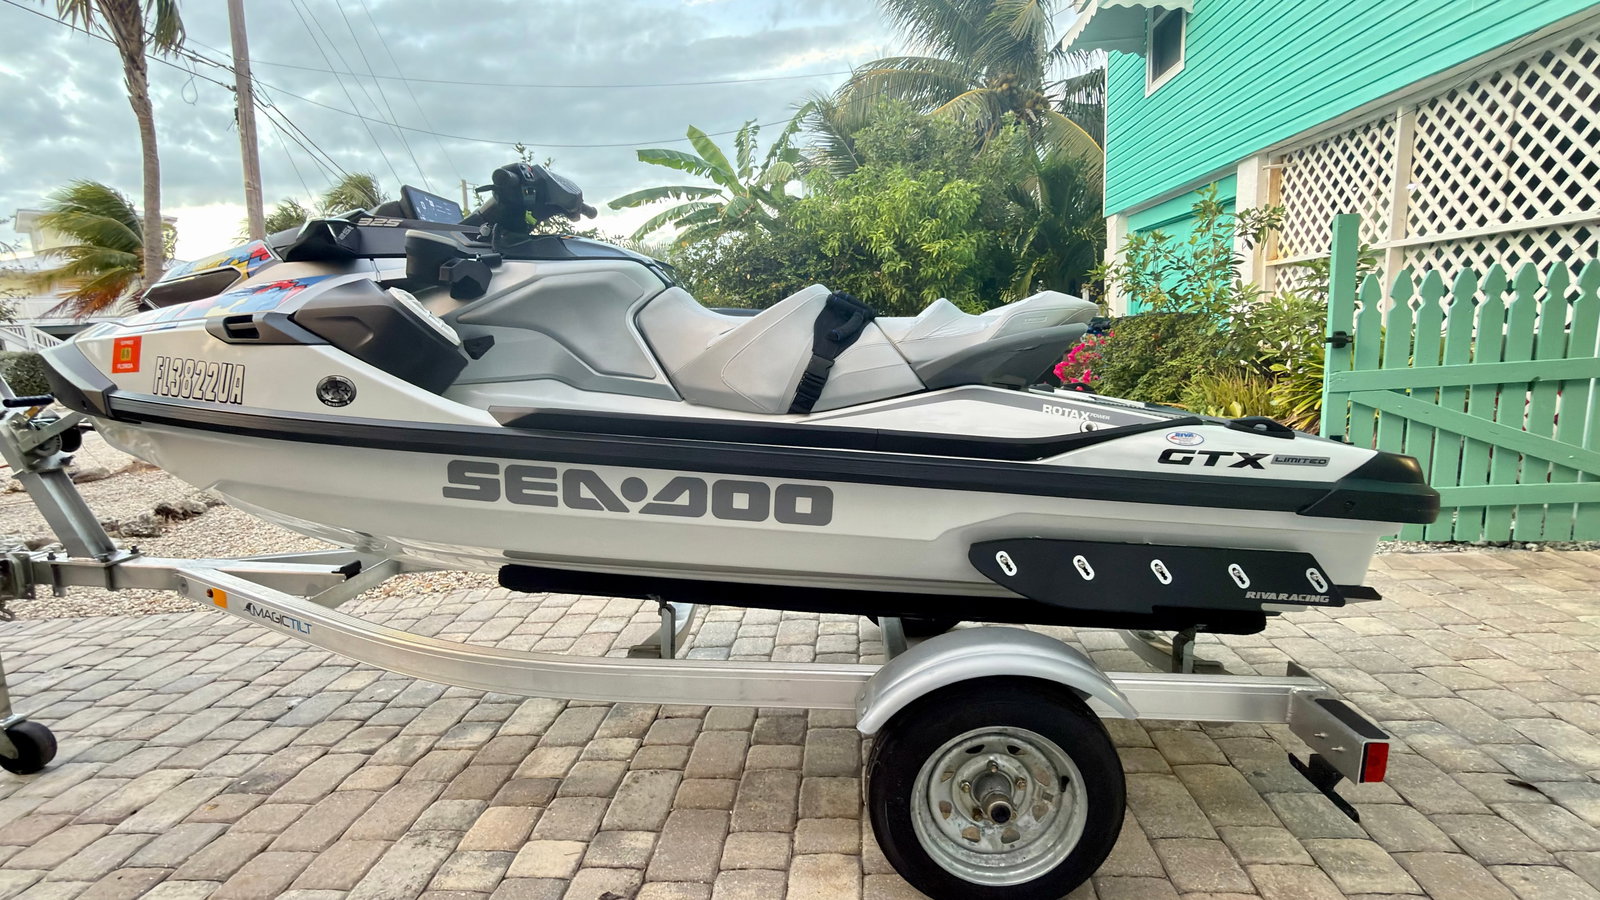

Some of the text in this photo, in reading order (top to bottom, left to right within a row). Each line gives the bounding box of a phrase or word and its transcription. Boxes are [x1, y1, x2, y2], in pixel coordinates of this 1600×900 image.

[357, 217, 403, 227] 325
[153, 356, 245, 405] FL3822UA
[1042, 404, 1090, 420] ROTAX
[1157, 448, 1329, 469] GTX LIMITED
